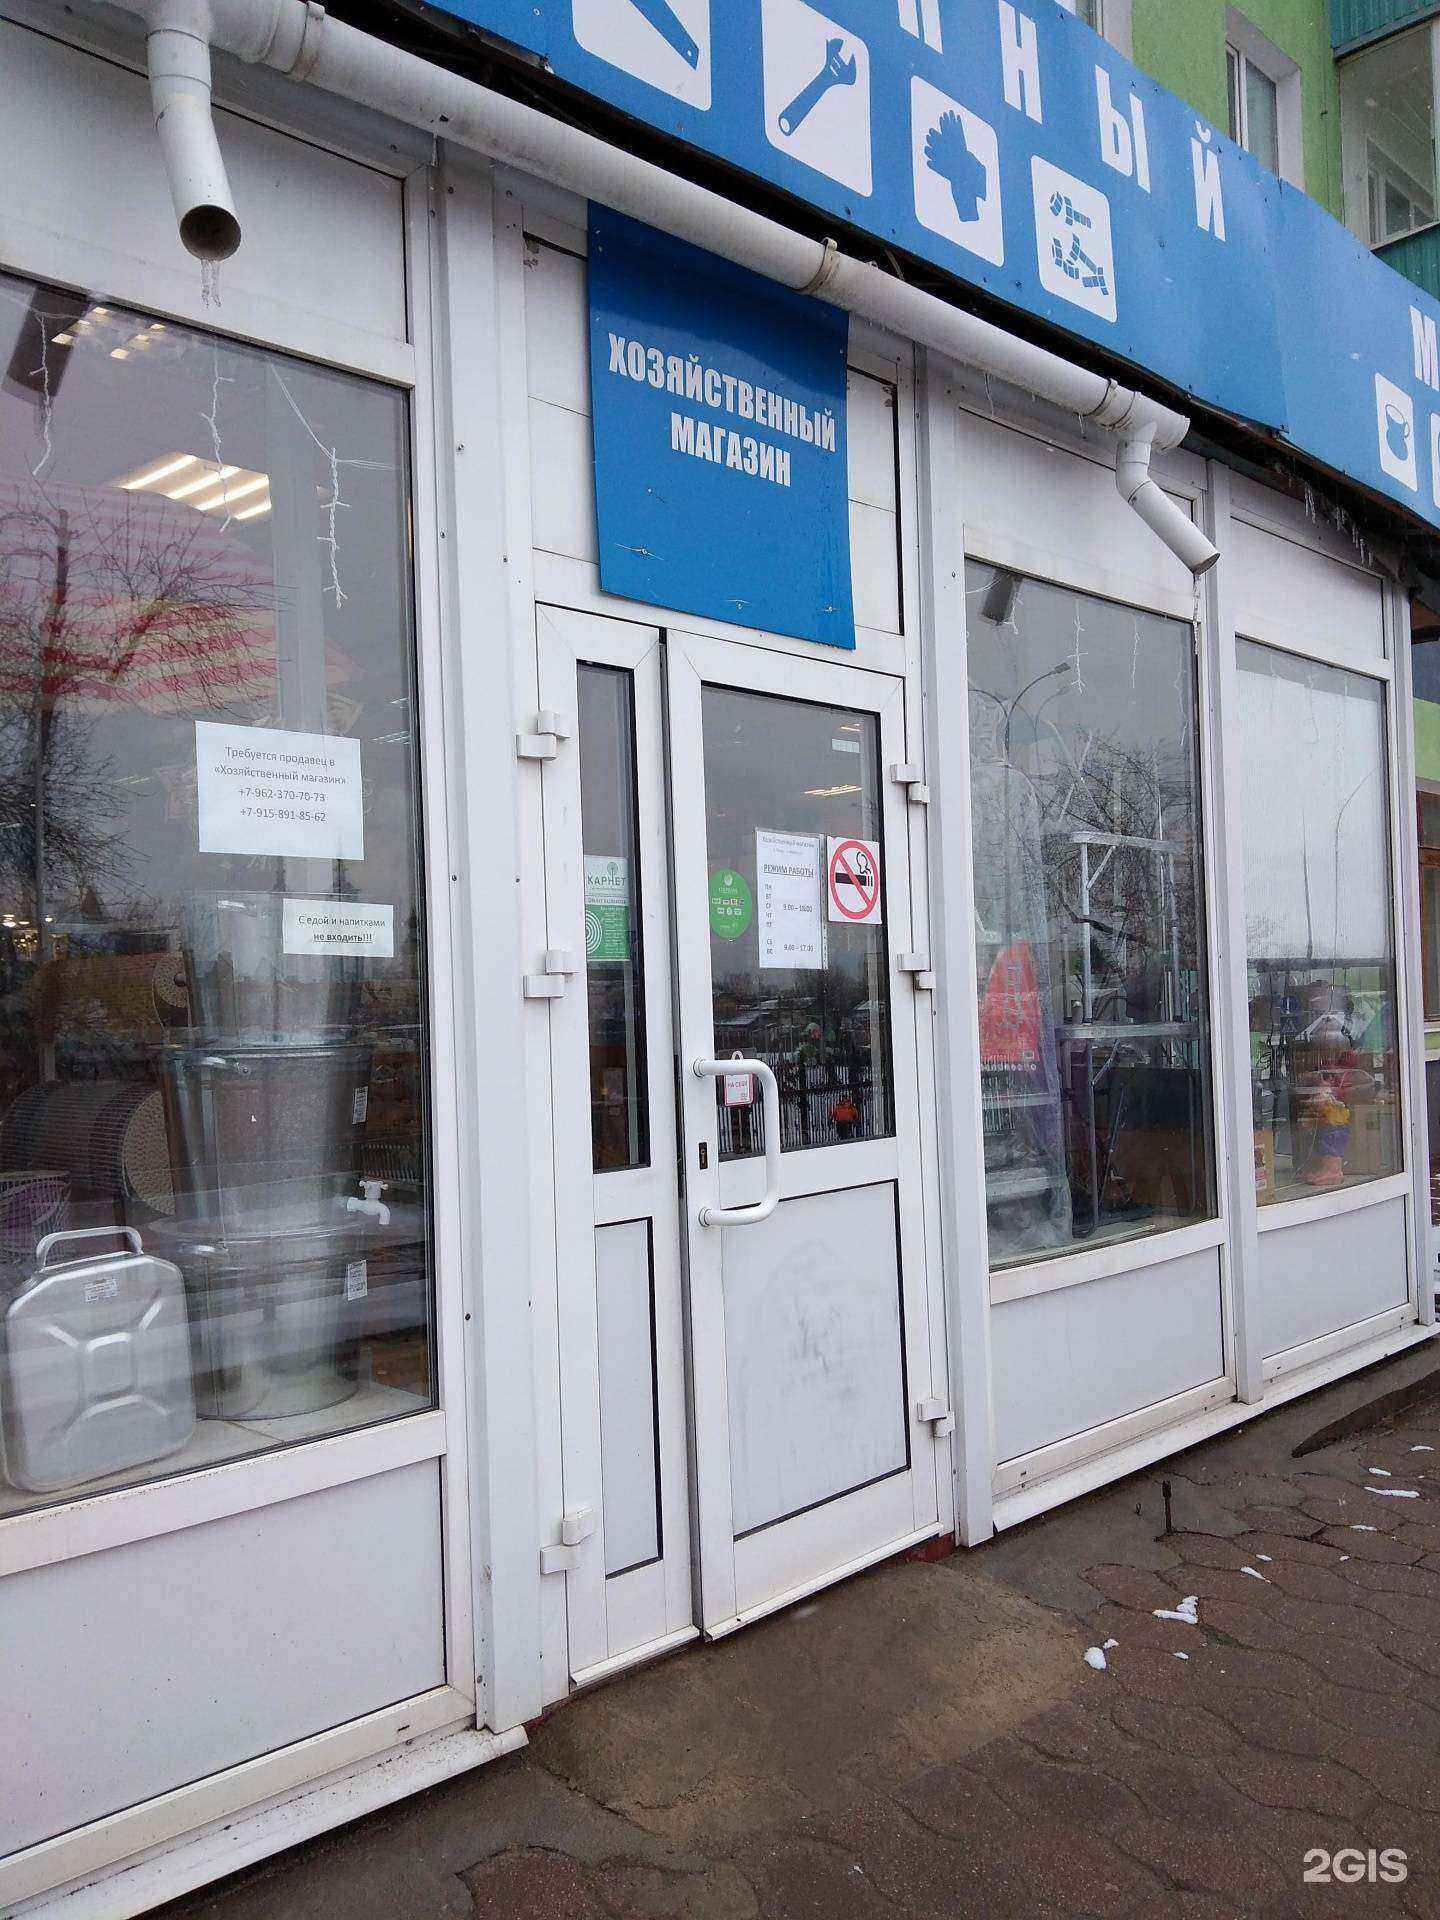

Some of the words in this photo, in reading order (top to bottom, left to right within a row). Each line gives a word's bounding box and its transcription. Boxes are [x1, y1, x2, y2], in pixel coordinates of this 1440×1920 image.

[608, 332, 836, 452] ХОЗЯЙСТВЕННЫЙ
[670, 412, 792, 487] МАГАЗИН
[225, 746, 277, 761] Требуется
[279, 753, 328, 767] продавец
[329, 759, 336, 767] в
[214, 764, 299, 781] «Хозяйственный
[301, 774, 347, 785] магазин»
[240, 807, 327, 822] +7-915-891-85-62
[763, 864, 788, 874] РЕЖИМ
[789, 866, 814, 877] РАБОТЫ
[587, 874, 626, 886] КАРНЕТ
[298, 914, 305, 924] С
[306, 916, 329, 926] едой
[339, 918, 387, 928] напитками
[313, 933, 325, 942] не
[326, 933, 373, 943] входить!!!
